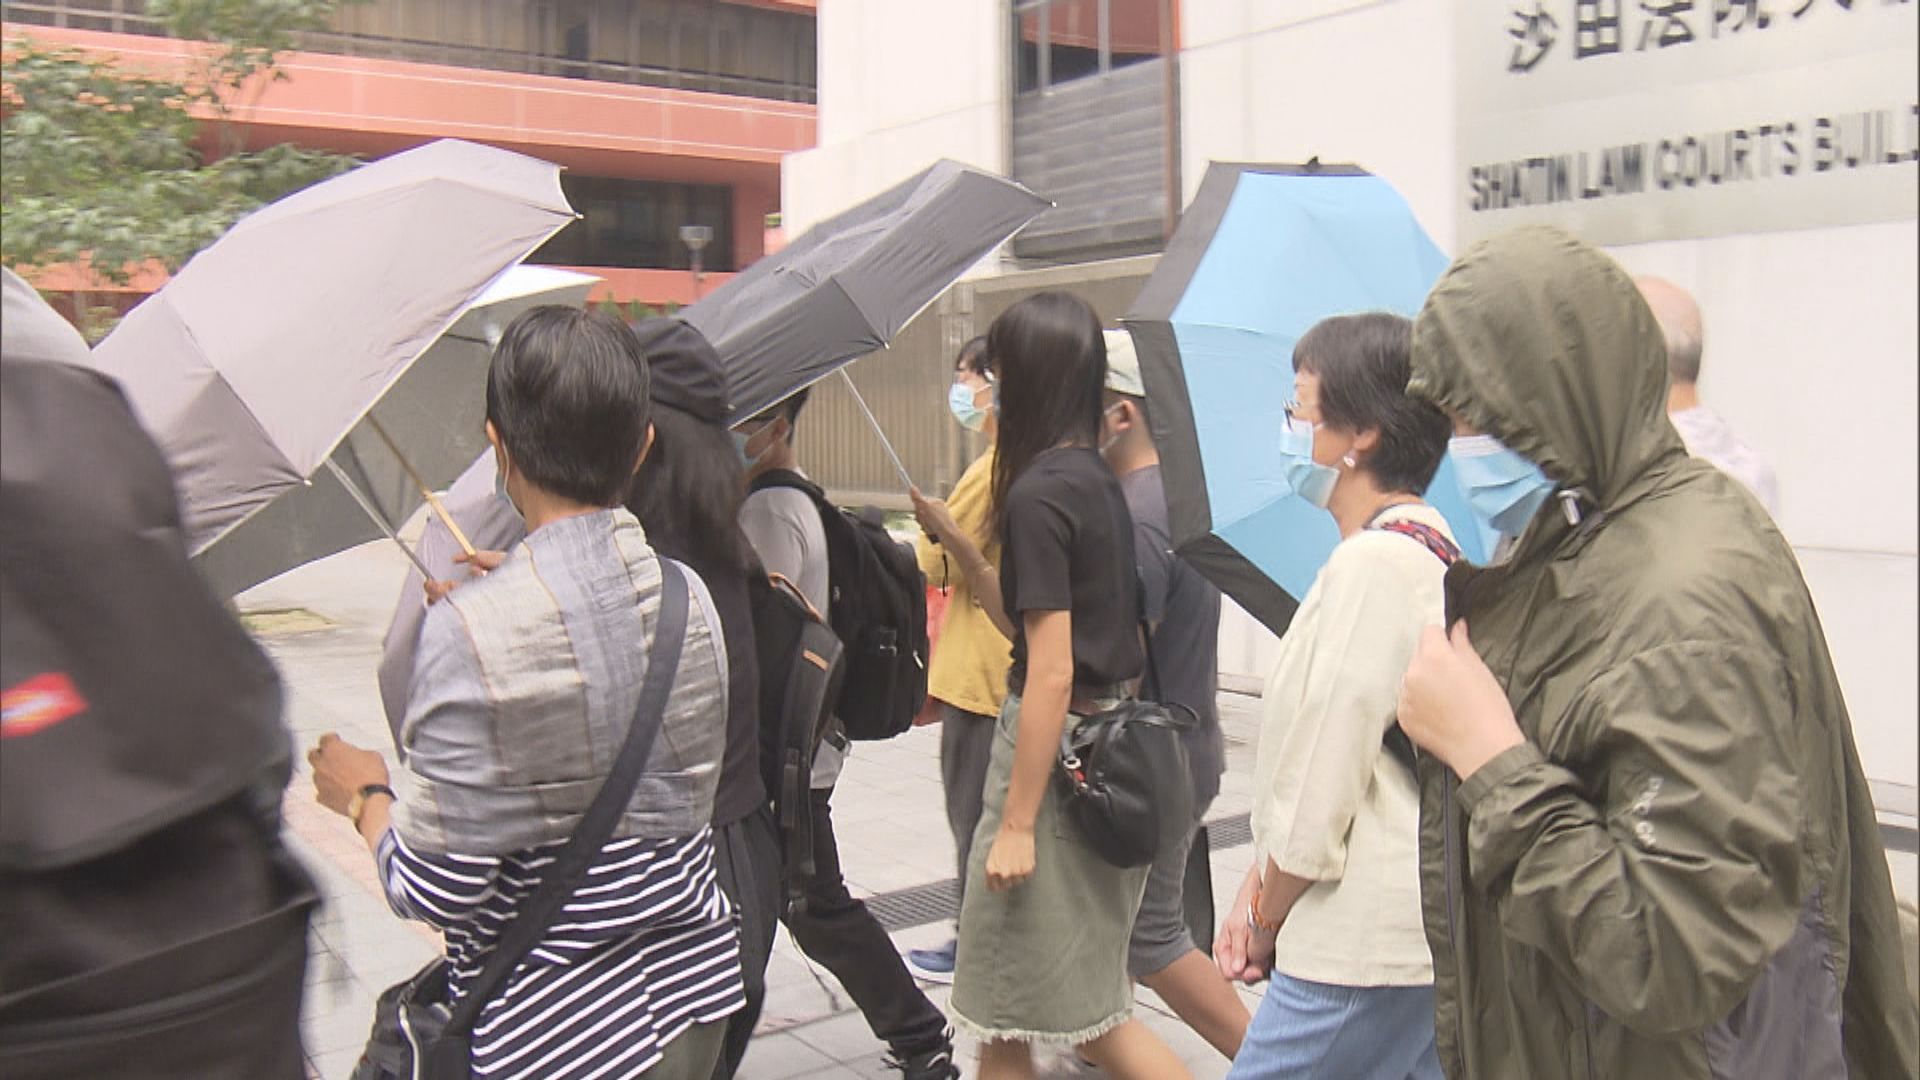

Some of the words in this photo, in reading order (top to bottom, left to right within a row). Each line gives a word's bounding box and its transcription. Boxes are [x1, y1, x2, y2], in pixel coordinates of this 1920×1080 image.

[1470, 151, 1573, 211] SHATIN
[1578, 142, 1647, 199] LAW
[1653, 121, 1799, 190] COURTS
